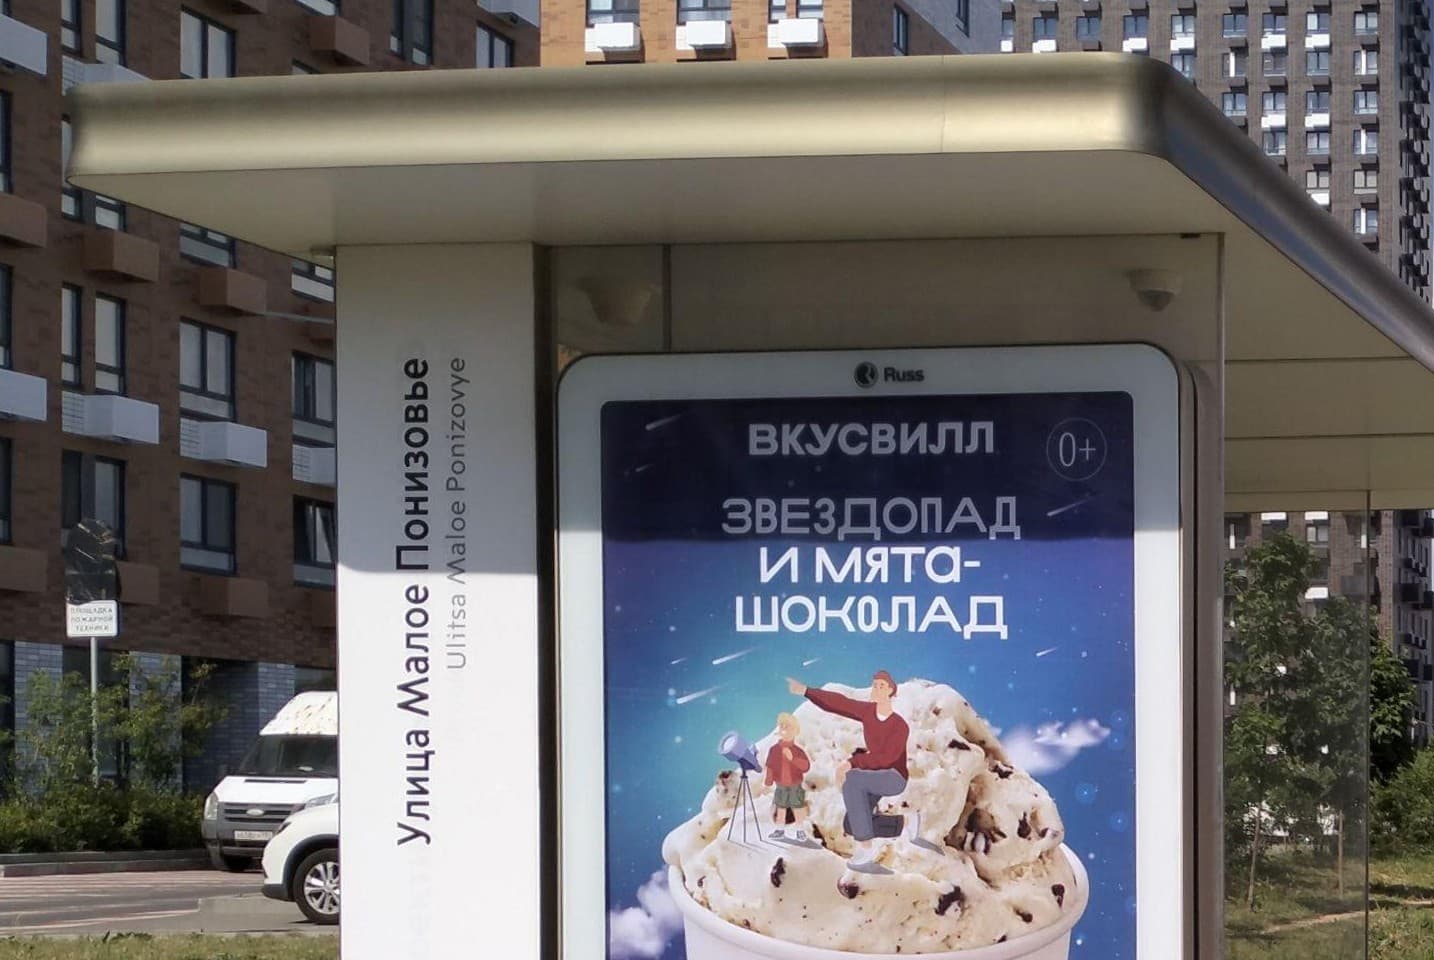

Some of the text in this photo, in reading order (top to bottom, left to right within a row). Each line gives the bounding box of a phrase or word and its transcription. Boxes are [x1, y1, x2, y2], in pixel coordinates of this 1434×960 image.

[883, 366, 925, 383] Russ
[748, 421, 994, 457] ВКУСВИЛЛ
[1058, 432, 1097, 467] 0+
[395, 358, 429, 570] Понизовье
[445, 357, 470, 669] Ulitsa Maloe Ponizovye
[721, 496, 1021, 541] ЗВЕЗДОПАД
[760, 547, 799, 584] И
[735, 596, 1008, 640] ШОКОЛАД
[396, 584, 430, 717] Малое
[397, 728, 435, 846] Улица
